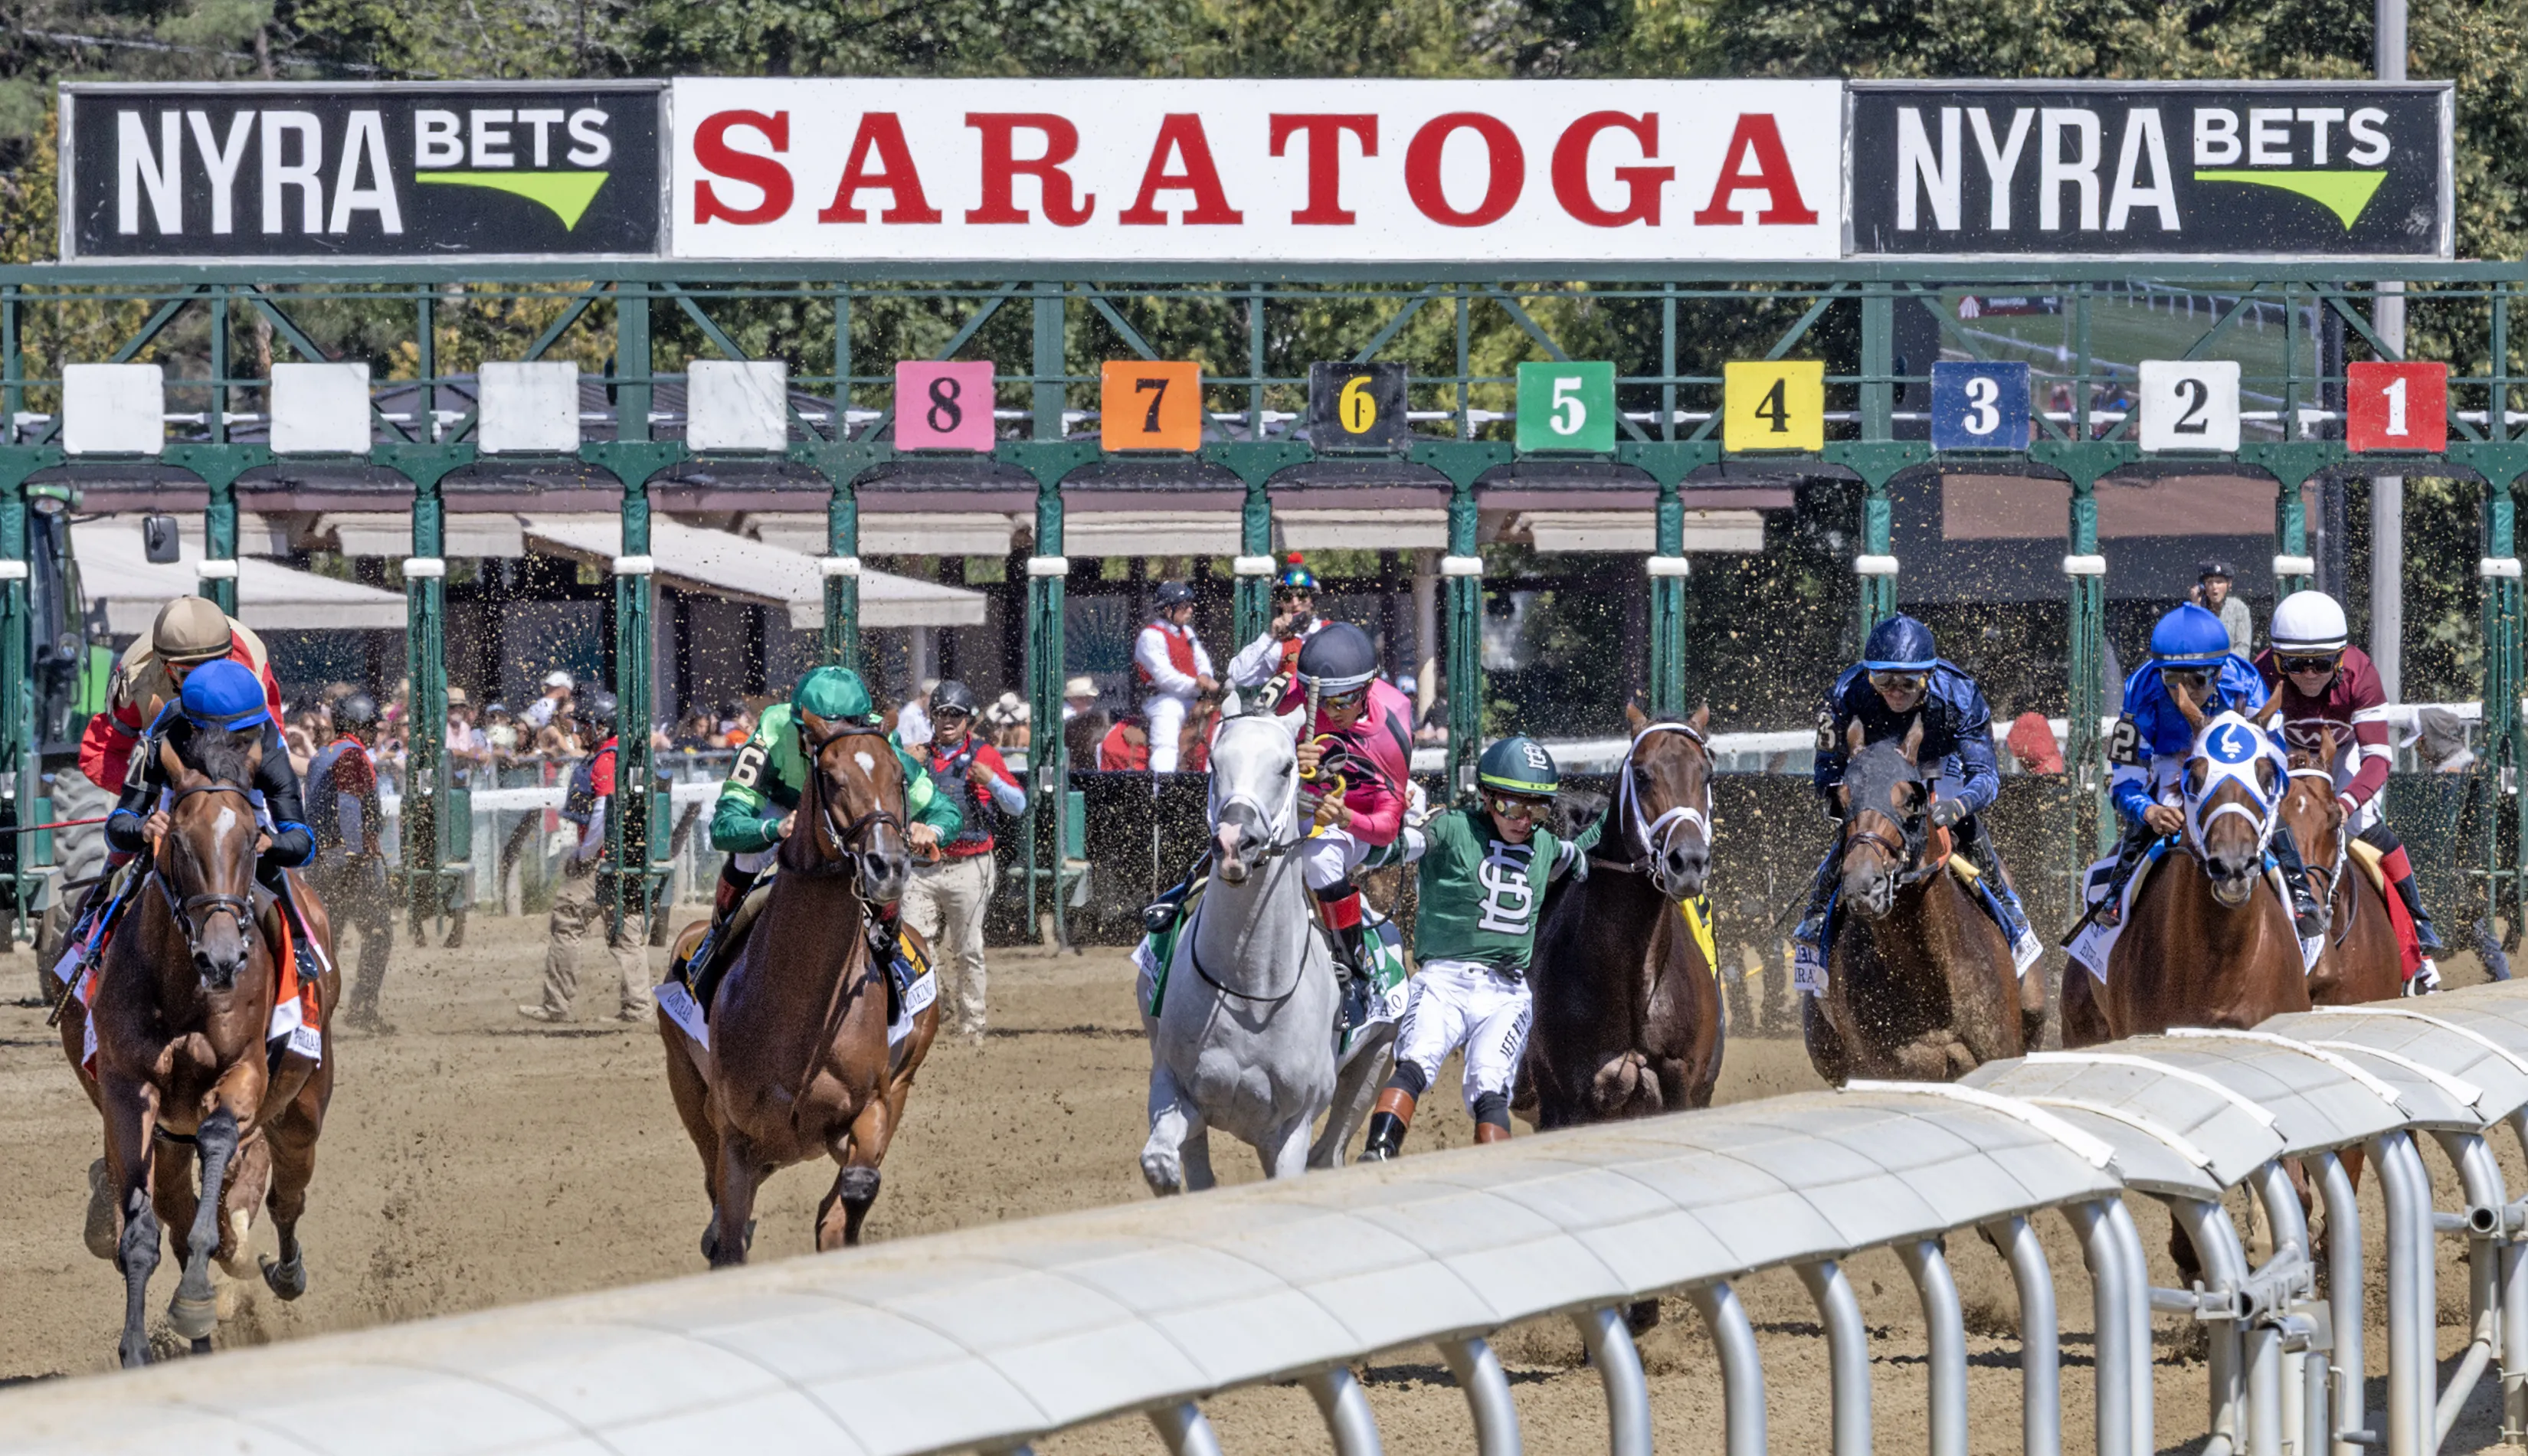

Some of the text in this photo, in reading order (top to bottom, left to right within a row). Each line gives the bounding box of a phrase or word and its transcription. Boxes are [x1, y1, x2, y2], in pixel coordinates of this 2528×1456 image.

[118, 108, 611, 234] NYRA BETS
[695, 110, 1818, 227] SARATOGA
[1898, 107, 2390, 231] NYRA BETS
[927, 378, 961, 433] 8
[1135, 378, 1169, 433] 7
[1339, 376, 1377, 434] 6
[1549, 377, 1587, 435] 5
[1755, 378, 1791, 432] 4
[1963, 378, 2000, 435] 3
[2173, 378, 2209, 434] 2
[2382, 377, 2408, 436] 1
[1253, 676, 1287, 709] 5
[1818, 712, 1836, 750] 3
[2112, 724, 2134, 761] 2
[731, 746, 765, 787] 6
[1500, 1031, 1518, 1060] JEFF
